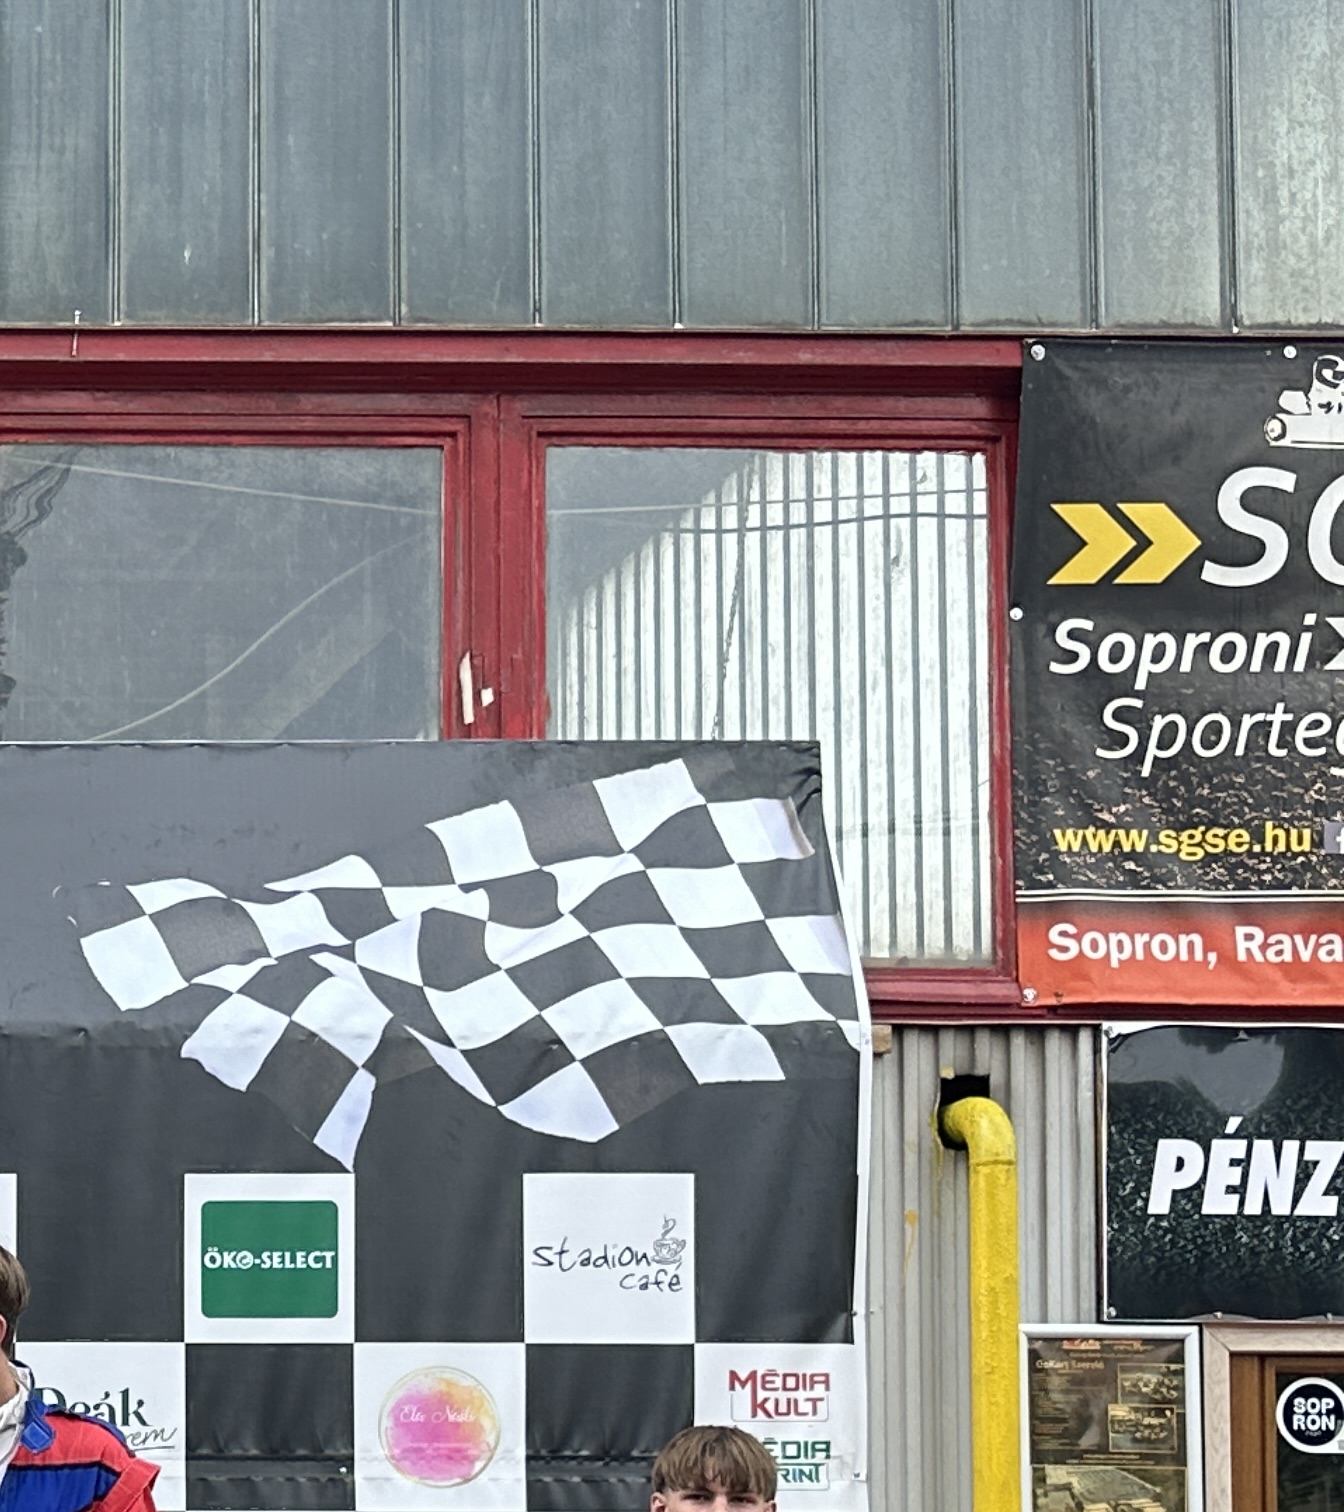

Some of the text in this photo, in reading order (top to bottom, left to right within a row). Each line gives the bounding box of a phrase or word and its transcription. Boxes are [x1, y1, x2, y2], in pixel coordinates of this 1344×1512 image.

[1048, 613, 1317, 690] Soproni
[1053, 822, 1311, 860] www.sgse.hu
[1047, 922, 1218, 969] Sopron,
[1147, 1116, 1344, 1216] PÉNZ
[203, 1246, 337, 1271] ÖKO-SELECT
[750, 1396, 826, 1420] KULT
[1293, 1396, 1335, 1414] SOP
[1292, 1413, 1335, 1432] RON
[762, 1437, 831, 1460] ÉDIA
[776, 1463, 826, 1483] RINT
